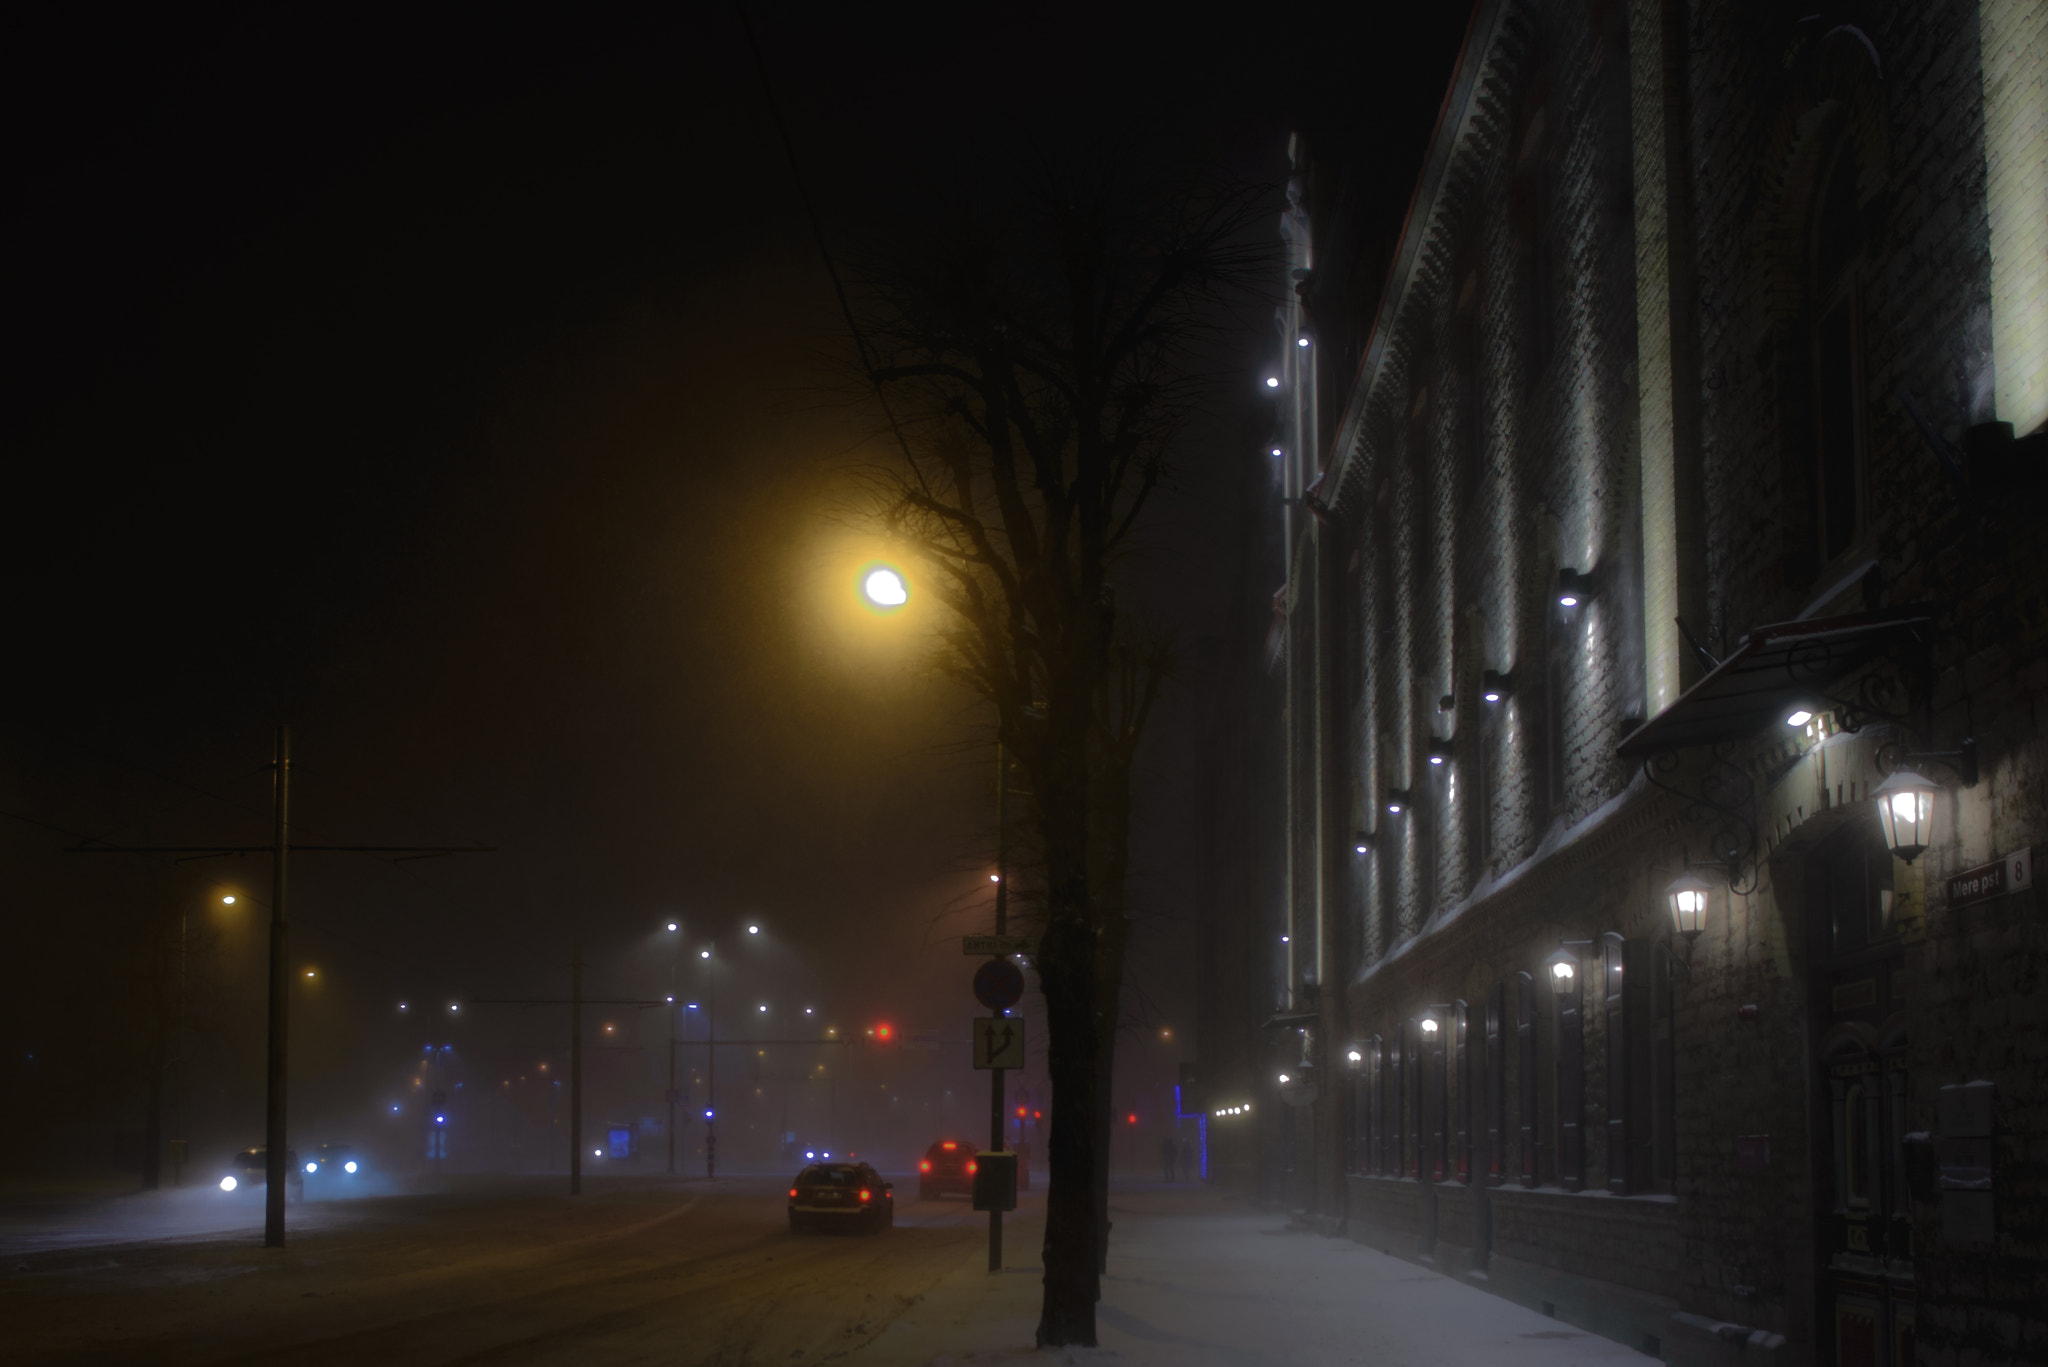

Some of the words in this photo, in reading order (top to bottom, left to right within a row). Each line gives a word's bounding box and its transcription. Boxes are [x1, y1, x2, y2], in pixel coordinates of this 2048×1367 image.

[1952, 878, 1979, 899] Mere
[1981, 867, 1999, 894] pst
[2015, 860, 2023, 882] 8
